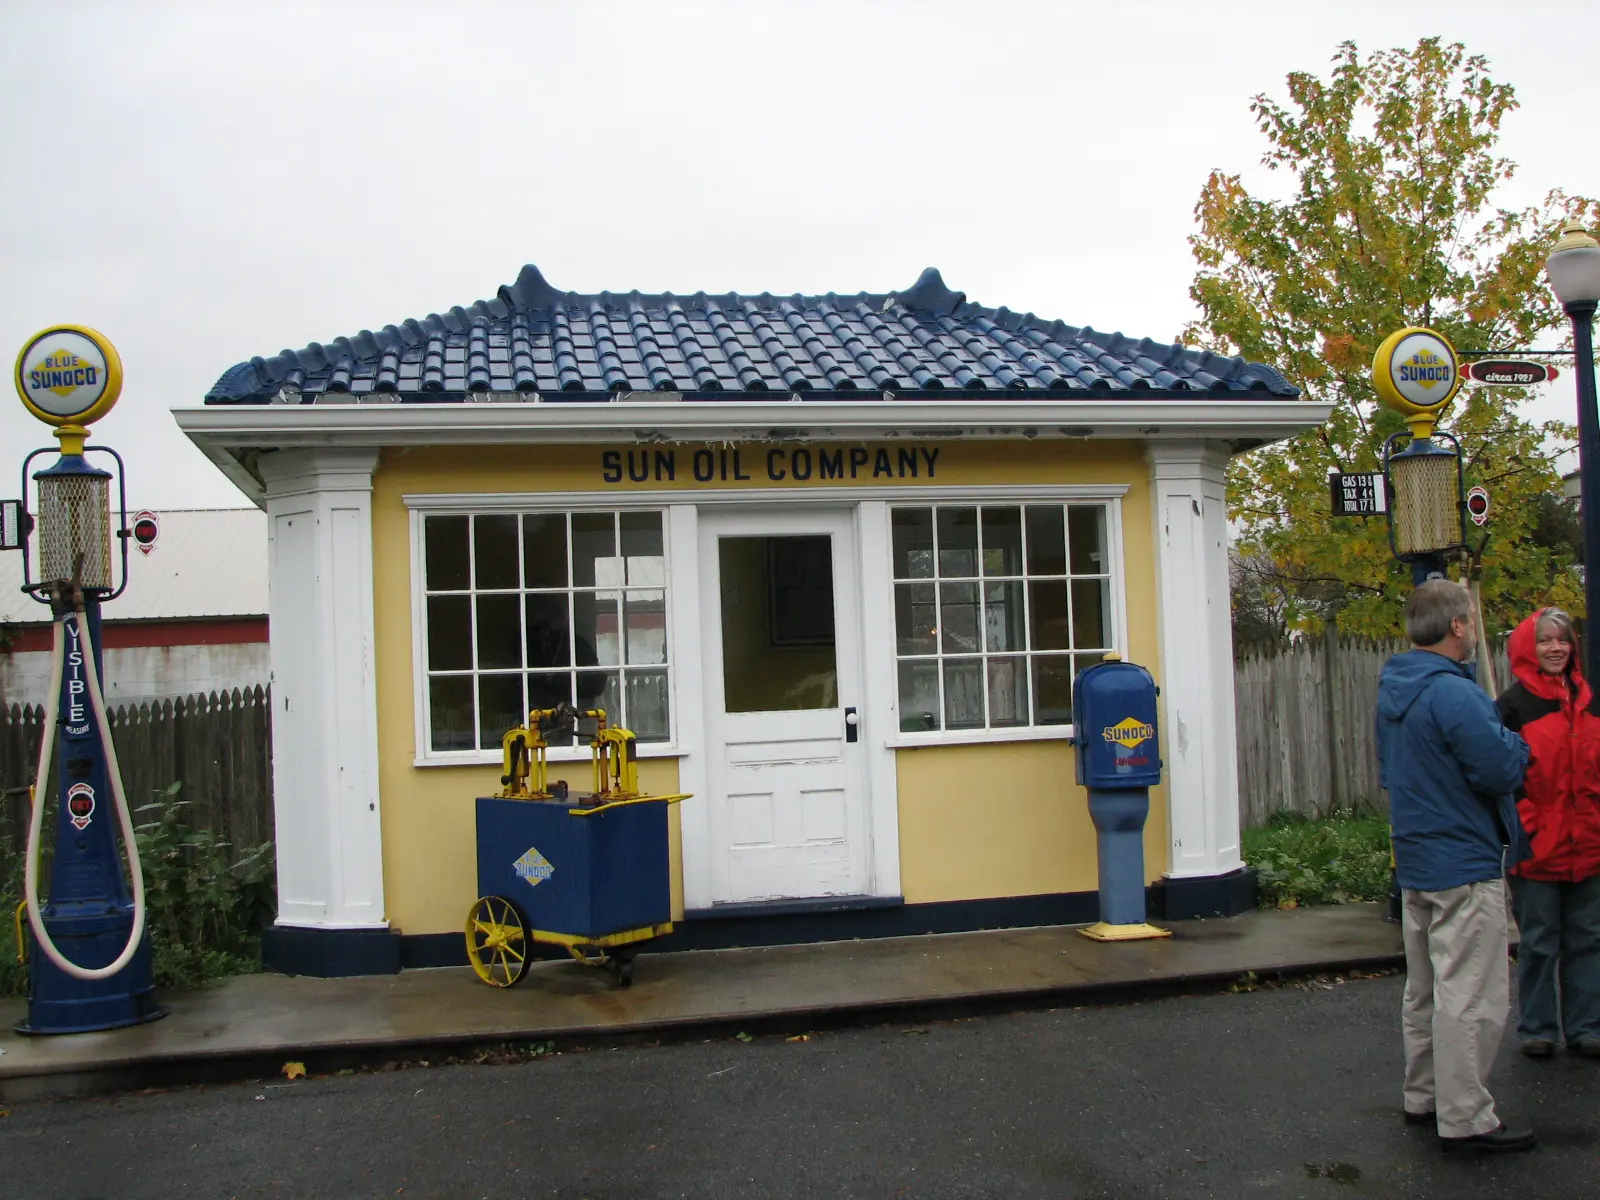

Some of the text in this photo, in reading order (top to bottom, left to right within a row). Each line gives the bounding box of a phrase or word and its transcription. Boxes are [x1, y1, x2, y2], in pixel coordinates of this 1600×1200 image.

[45, 356, 79, 368] BLUE
[1412, 355, 1439, 365] BLUE
[31, 367, 97, 390] SUNOCO
[1400, 366, 1449, 382] SUNOCO
[1485, 372, 1513, 382] circa
[602, 446, 941, 483] SUN OIL COMPANY
[1341, 475, 1357, 488] GAS
[1357, 475, 1367, 487] 13
[1343, 488, 1357, 499] TAX
[1344, 500, 1358, 512] TOTAL
[1359, 500, 1368, 512] 17
[66, 623, 85, 722] VISIBLE
[1104, 724, 1153, 741] SUNOCO
[516, 862, 552, 879] SUNOCO
